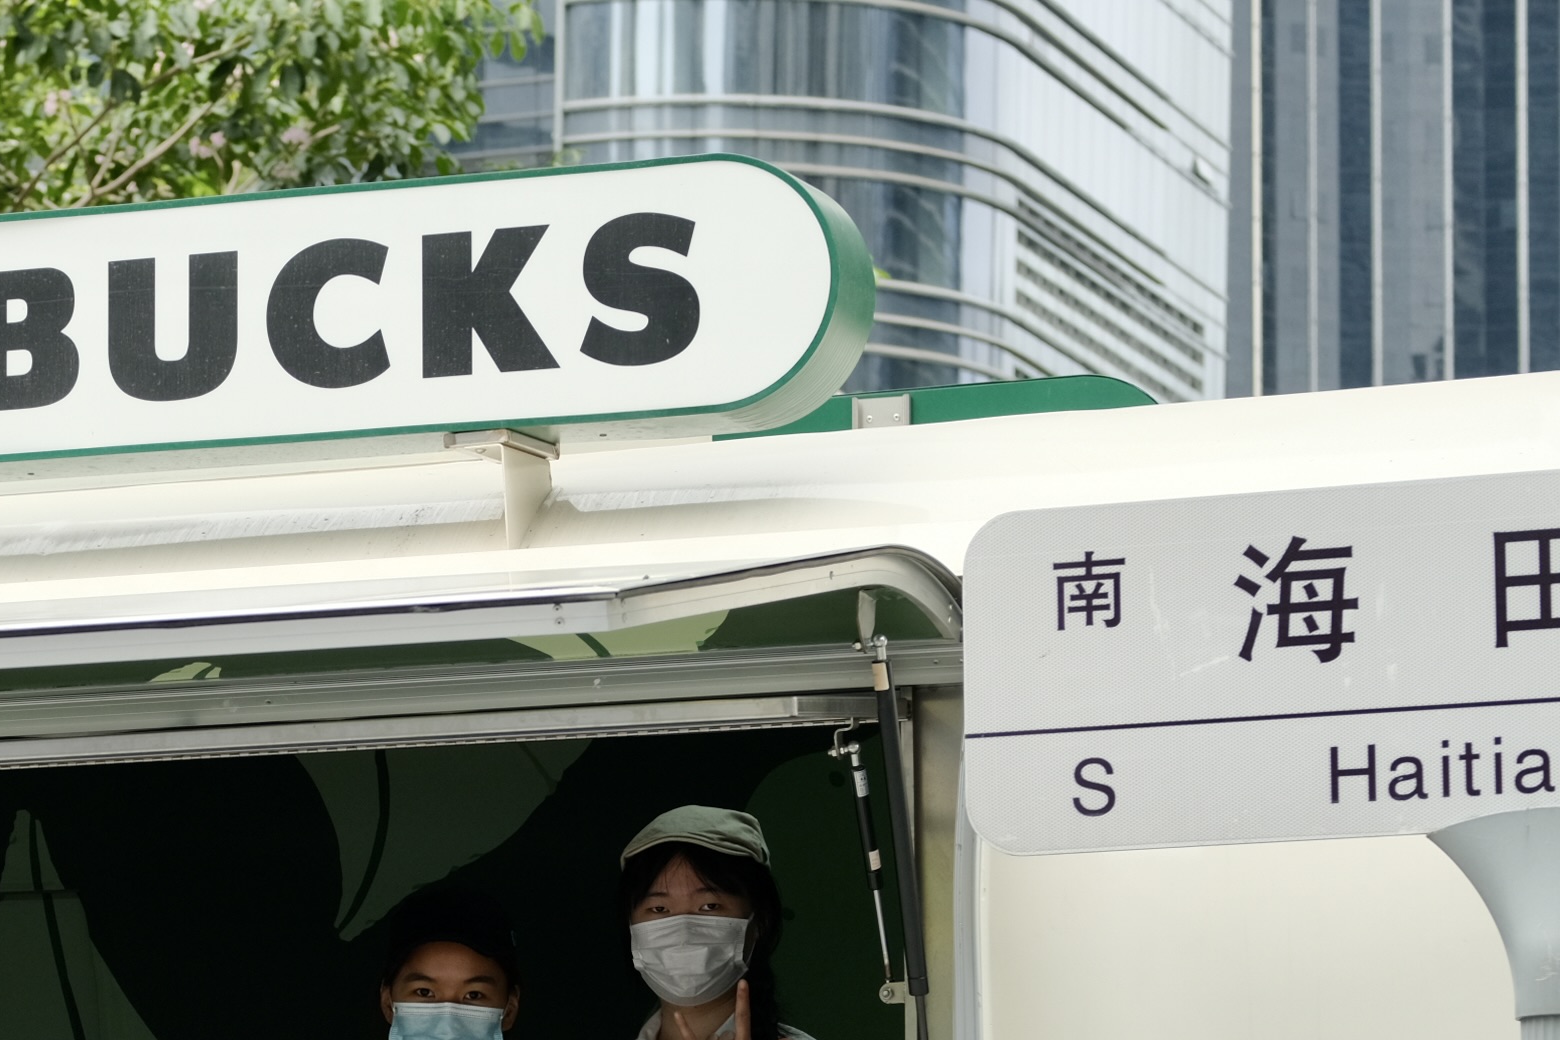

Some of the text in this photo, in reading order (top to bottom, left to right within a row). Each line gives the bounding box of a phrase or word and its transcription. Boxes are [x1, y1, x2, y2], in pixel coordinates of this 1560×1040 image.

[1052, 550, 1126, 632] 南
[1072, 736, 1556, 817] S Haitia
